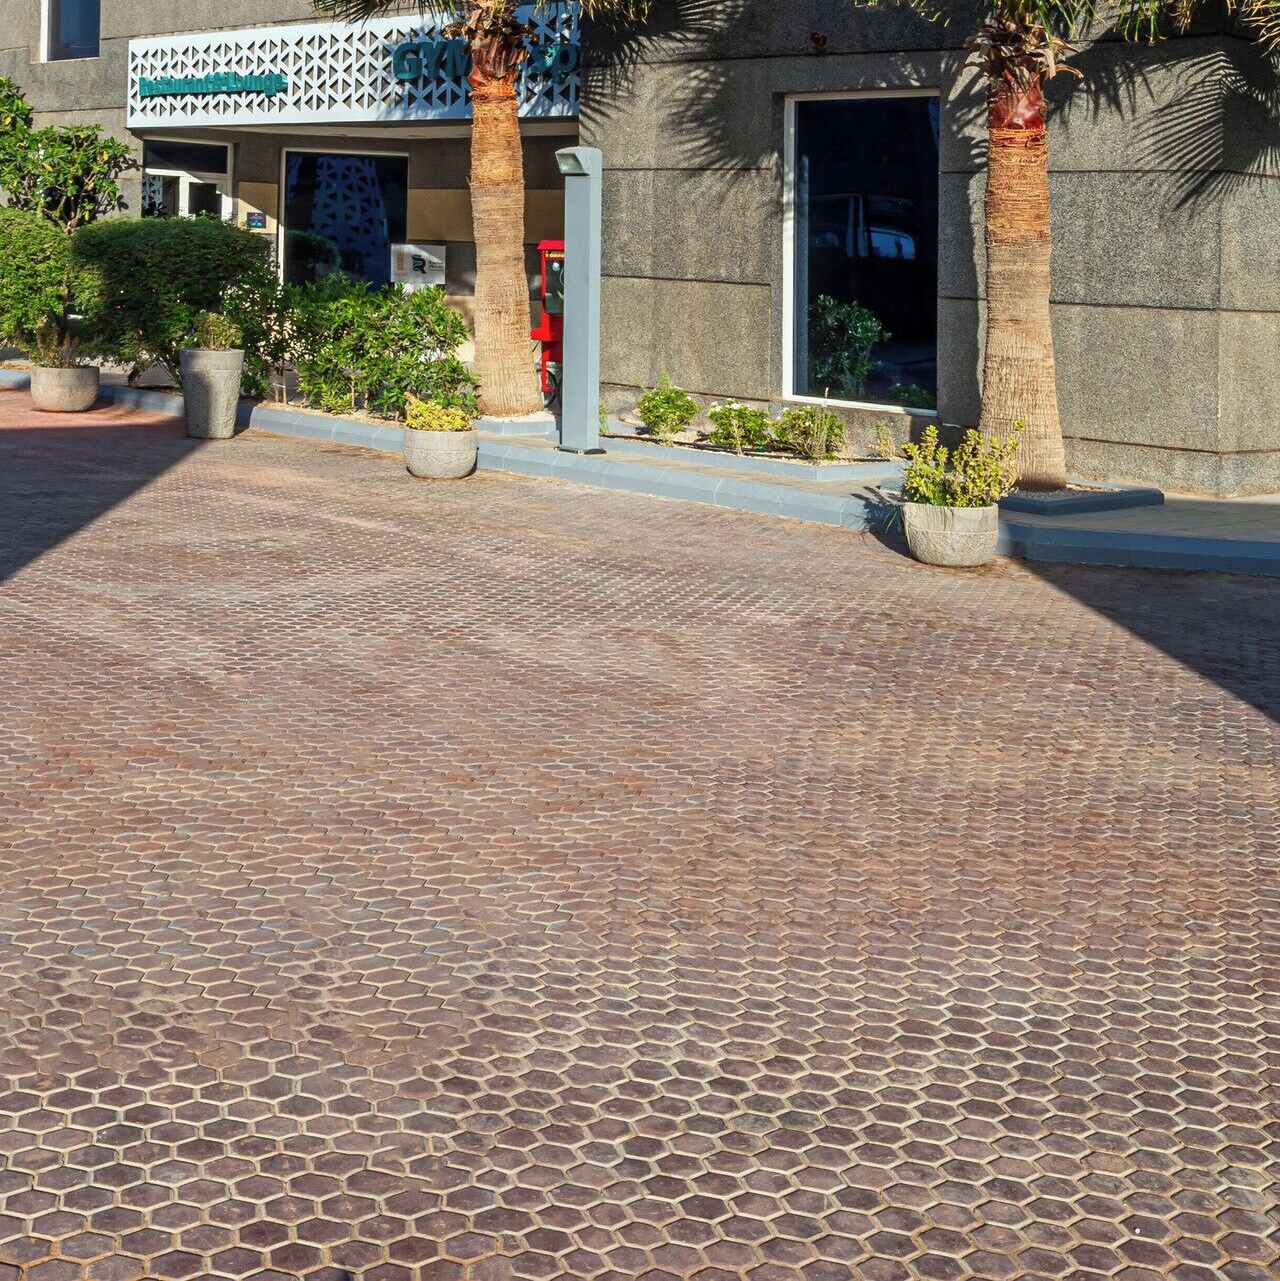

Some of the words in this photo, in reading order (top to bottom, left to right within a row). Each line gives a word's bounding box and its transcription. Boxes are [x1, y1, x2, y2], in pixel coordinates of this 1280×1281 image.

[393, 39, 472, 80] GYM
[139, 74, 214, 97] Restaurant
[227, 71, 288, 98] Lounge
